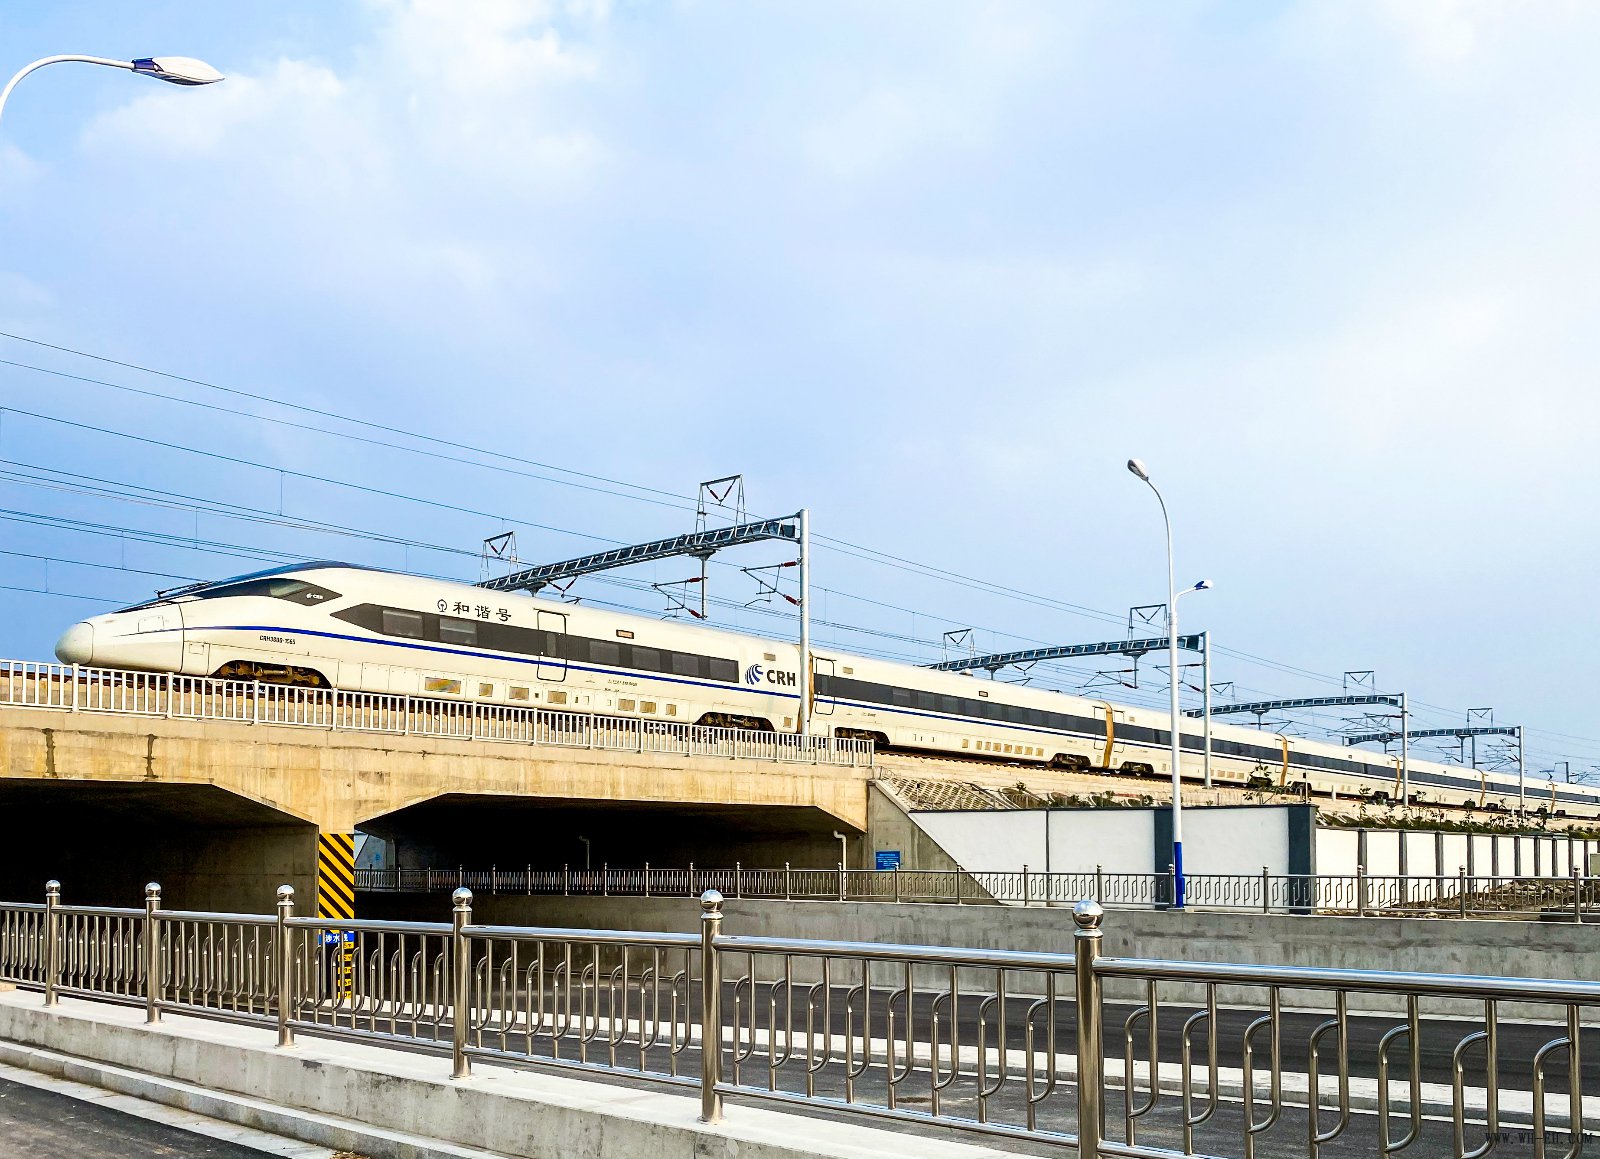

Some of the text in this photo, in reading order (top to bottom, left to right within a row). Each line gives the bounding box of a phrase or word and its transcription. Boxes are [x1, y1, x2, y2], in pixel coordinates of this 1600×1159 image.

[453, 601, 512, 621] 和谐号
[766, 669, 796, 687] CRH
